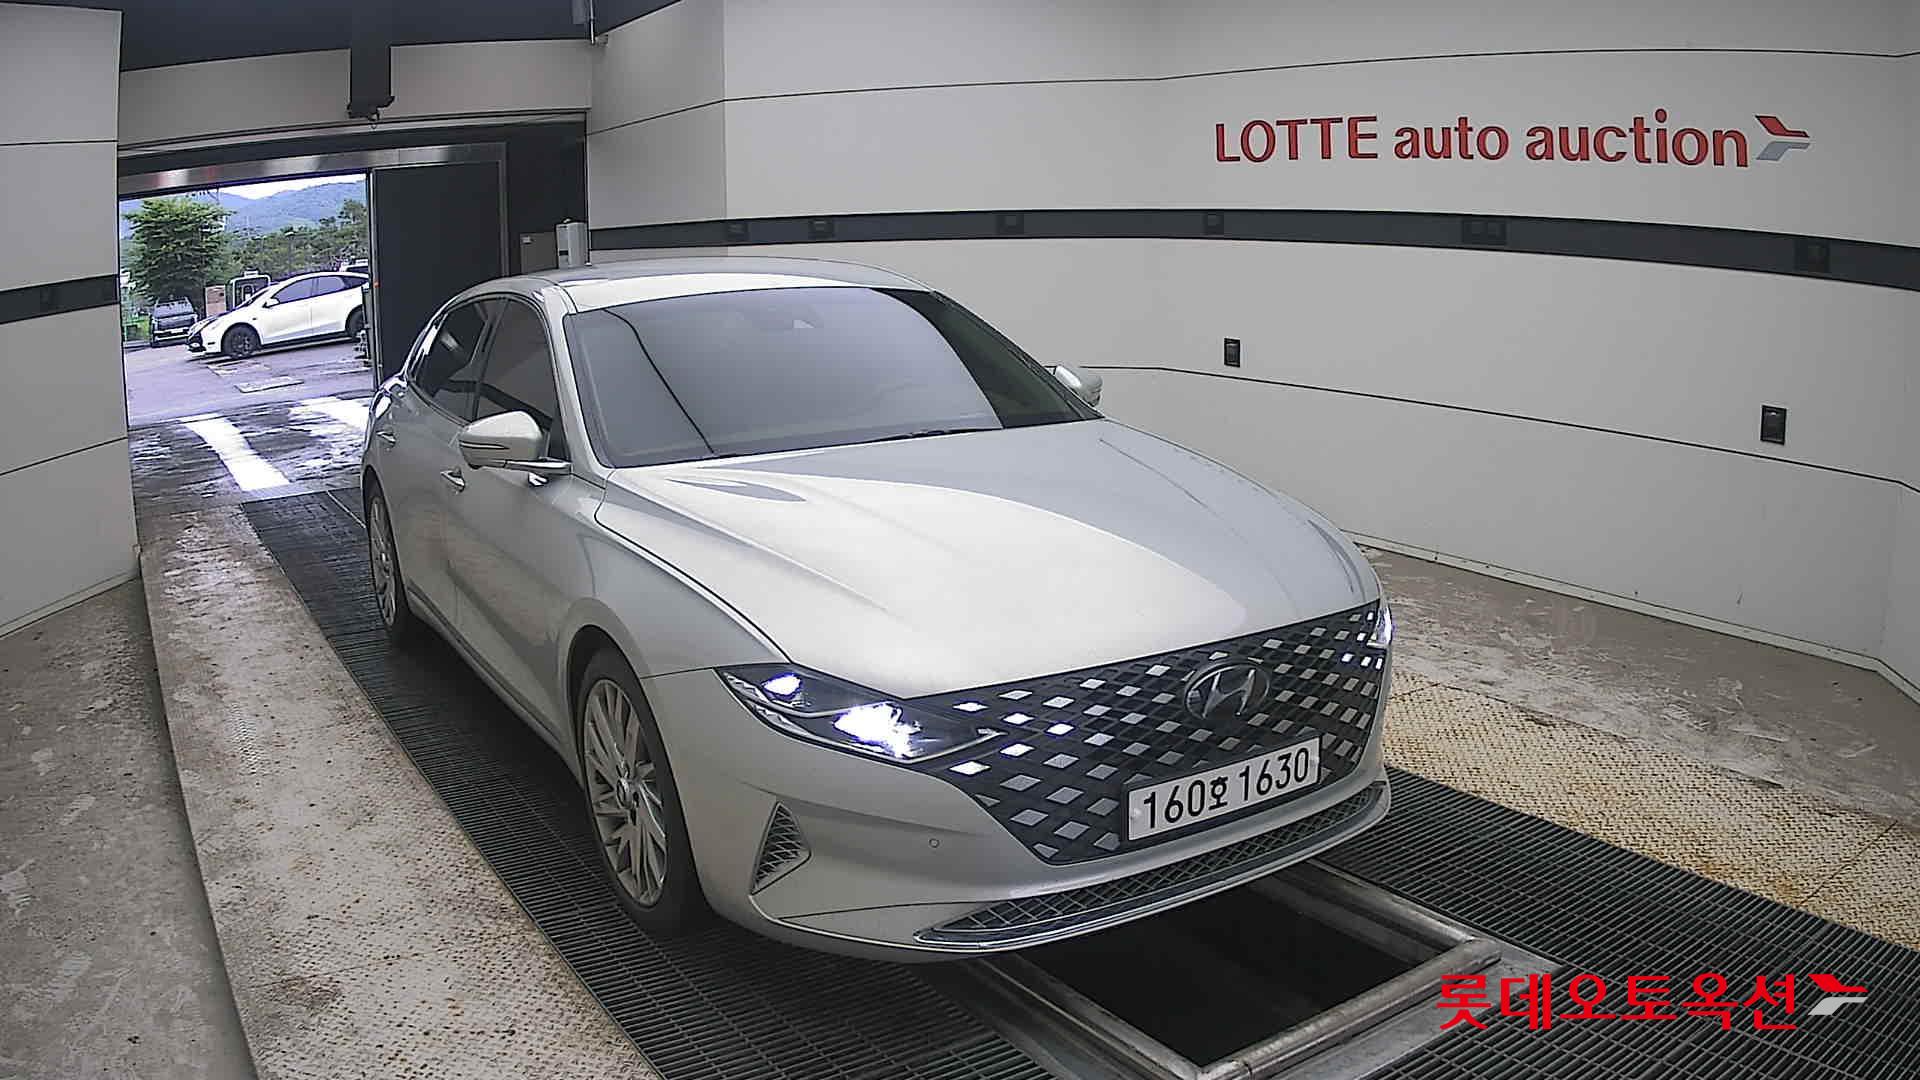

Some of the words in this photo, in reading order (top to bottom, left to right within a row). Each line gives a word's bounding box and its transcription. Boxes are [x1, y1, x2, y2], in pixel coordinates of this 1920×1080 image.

[1214, 115, 1378, 162] LOTTE
[1393, 116, 1509, 161] auto
[1525, 108, 1749, 168] auction
[1143, 776, 1229, 829] 160호
[1239, 747, 1309, 802] 1630
